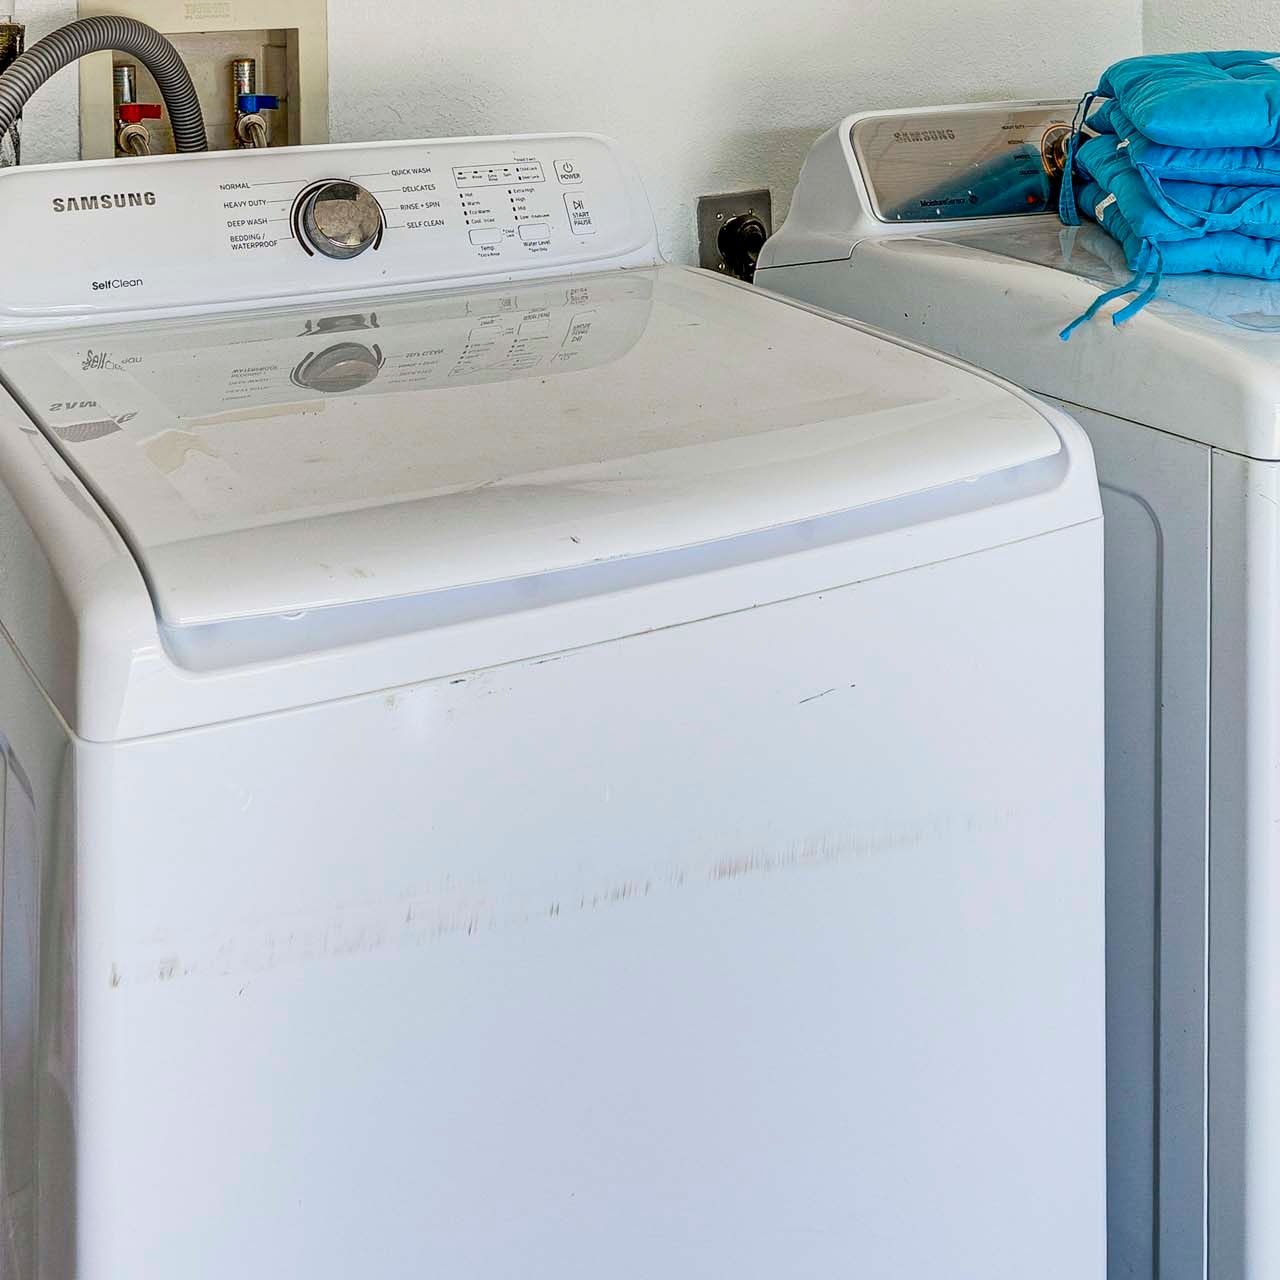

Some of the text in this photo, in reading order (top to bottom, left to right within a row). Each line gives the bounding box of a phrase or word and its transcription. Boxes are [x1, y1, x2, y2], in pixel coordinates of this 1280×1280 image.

[411, 167, 432, 175] WASH
[219, 182, 251, 190] NORMAL
[402, 183, 436, 193] DELICATES
[52, 191, 156, 213] SAMSUNG
[223, 199, 267, 209] HEAVY DUTY
[400, 202, 419, 211] RINSE
[227, 218, 268, 228] DEEP WASH
[229, 233, 261, 242] BEDDING
[231, 240, 278, 250] WATERPROOF
[92, 277, 144, 291] SelfClean
